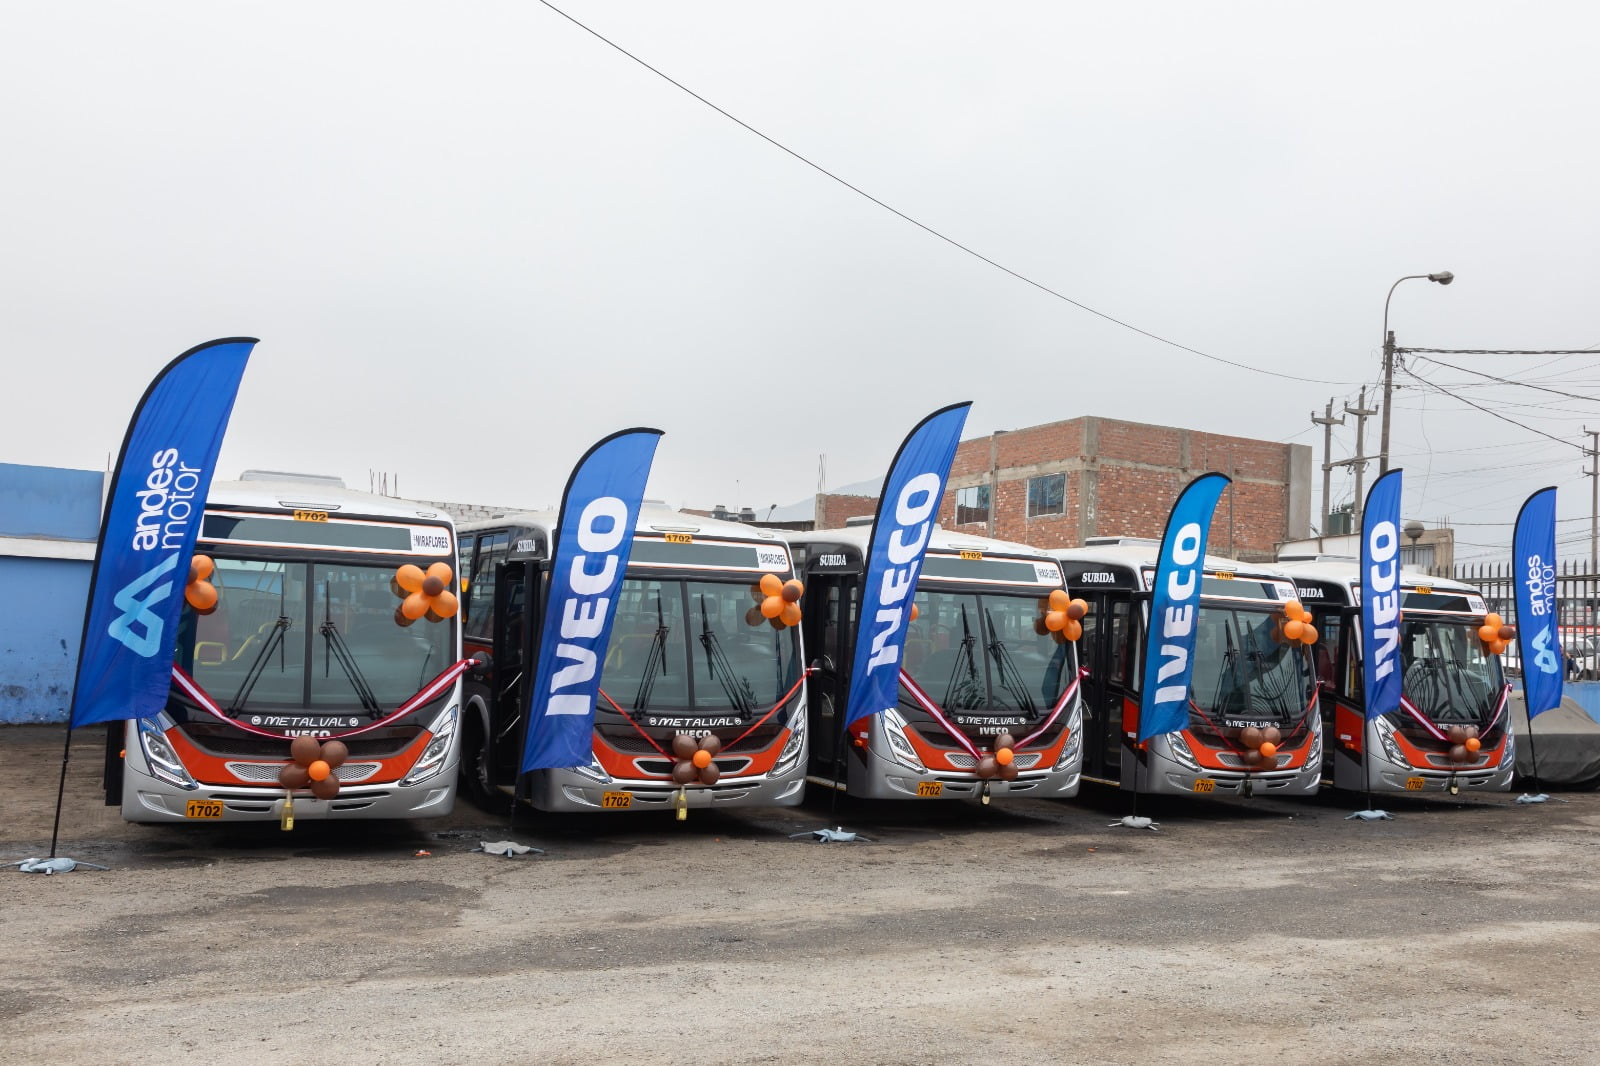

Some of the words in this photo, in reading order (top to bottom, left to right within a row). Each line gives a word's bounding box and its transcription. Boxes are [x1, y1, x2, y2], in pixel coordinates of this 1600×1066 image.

[132, 448, 178, 551] andes
[161, 461, 202, 549] motor
[295, 511, 327, 522] 1702
[415, 534, 449, 549] MIRAFLORES
[666, 534, 691, 543] 1702
[819, 554, 847, 566] SUBIDA
[961, 552, 981, 560] 1702
[866, 472, 941, 677] IVECO
[1081, 572, 1116, 584] SUBIDA
[1525, 554, 1546, 616] andes
[1542, 562, 1555, 614] motor
[1298, 587, 1325, 598] BIDA
[545, 496, 628, 716] IVECO
[1369, 520, 1399, 682] IVECO
[1154, 522, 1201, 705] IVECO
[263, 716, 347, 727] METALVAL
[657, 717, 734, 727] METALVAL
[966, 716, 1019, 725] METALVAL
[675, 729, 712, 738] IVECO
[979, 727, 1009, 735] IVECO
[1195, 784, 1213, 793] 1702
[1406, 780, 1423, 790] 1702
[919, 786, 941, 796] 1702
[604, 796, 630, 807] 1702
[189, 805, 221, 817] 1702
